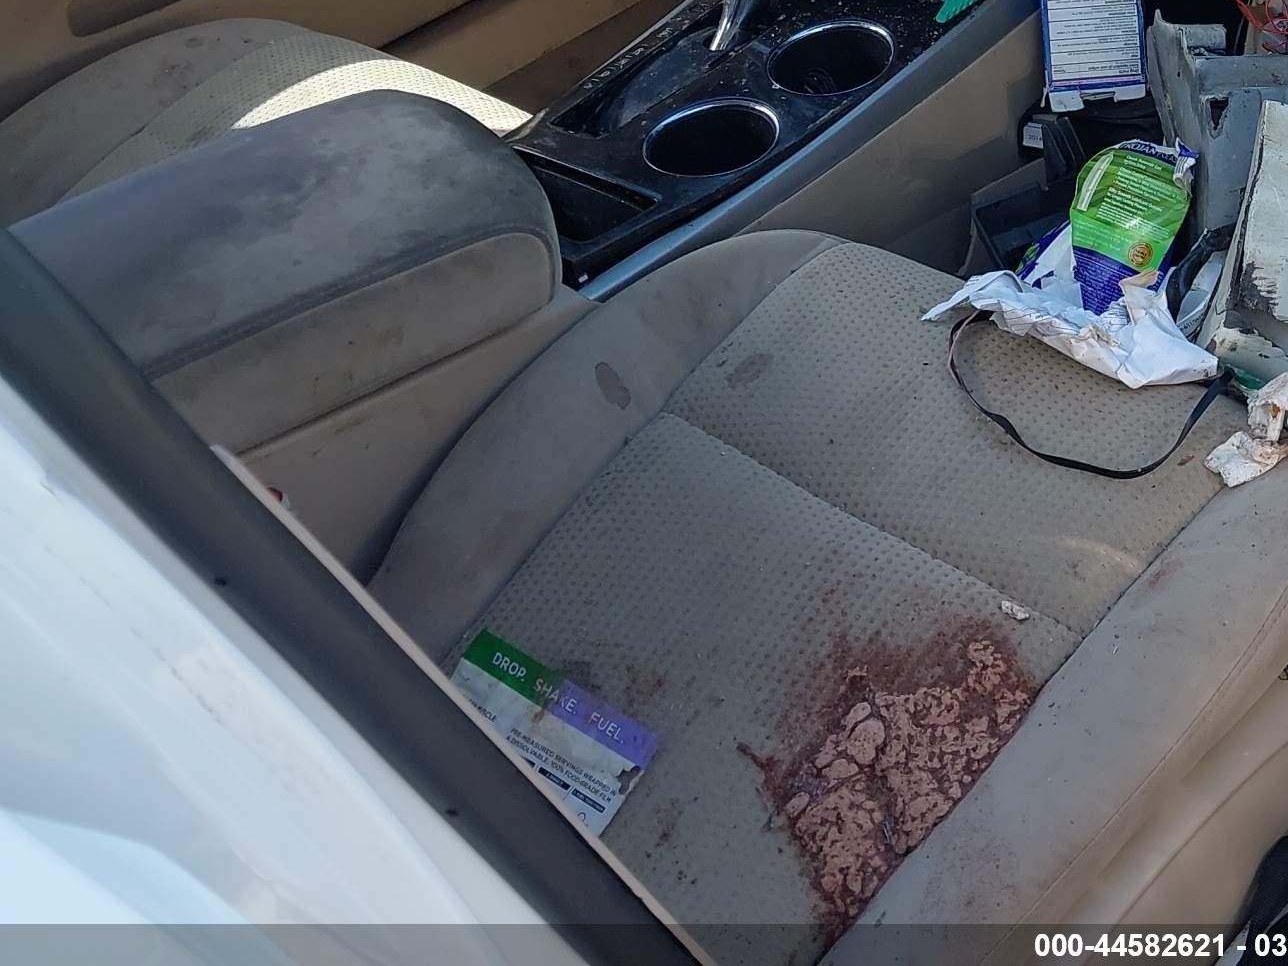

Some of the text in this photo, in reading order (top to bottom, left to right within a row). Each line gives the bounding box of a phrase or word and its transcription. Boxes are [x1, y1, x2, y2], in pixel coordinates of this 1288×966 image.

[492, 652, 624, 744] DROP. SHAKE. FUEL.
